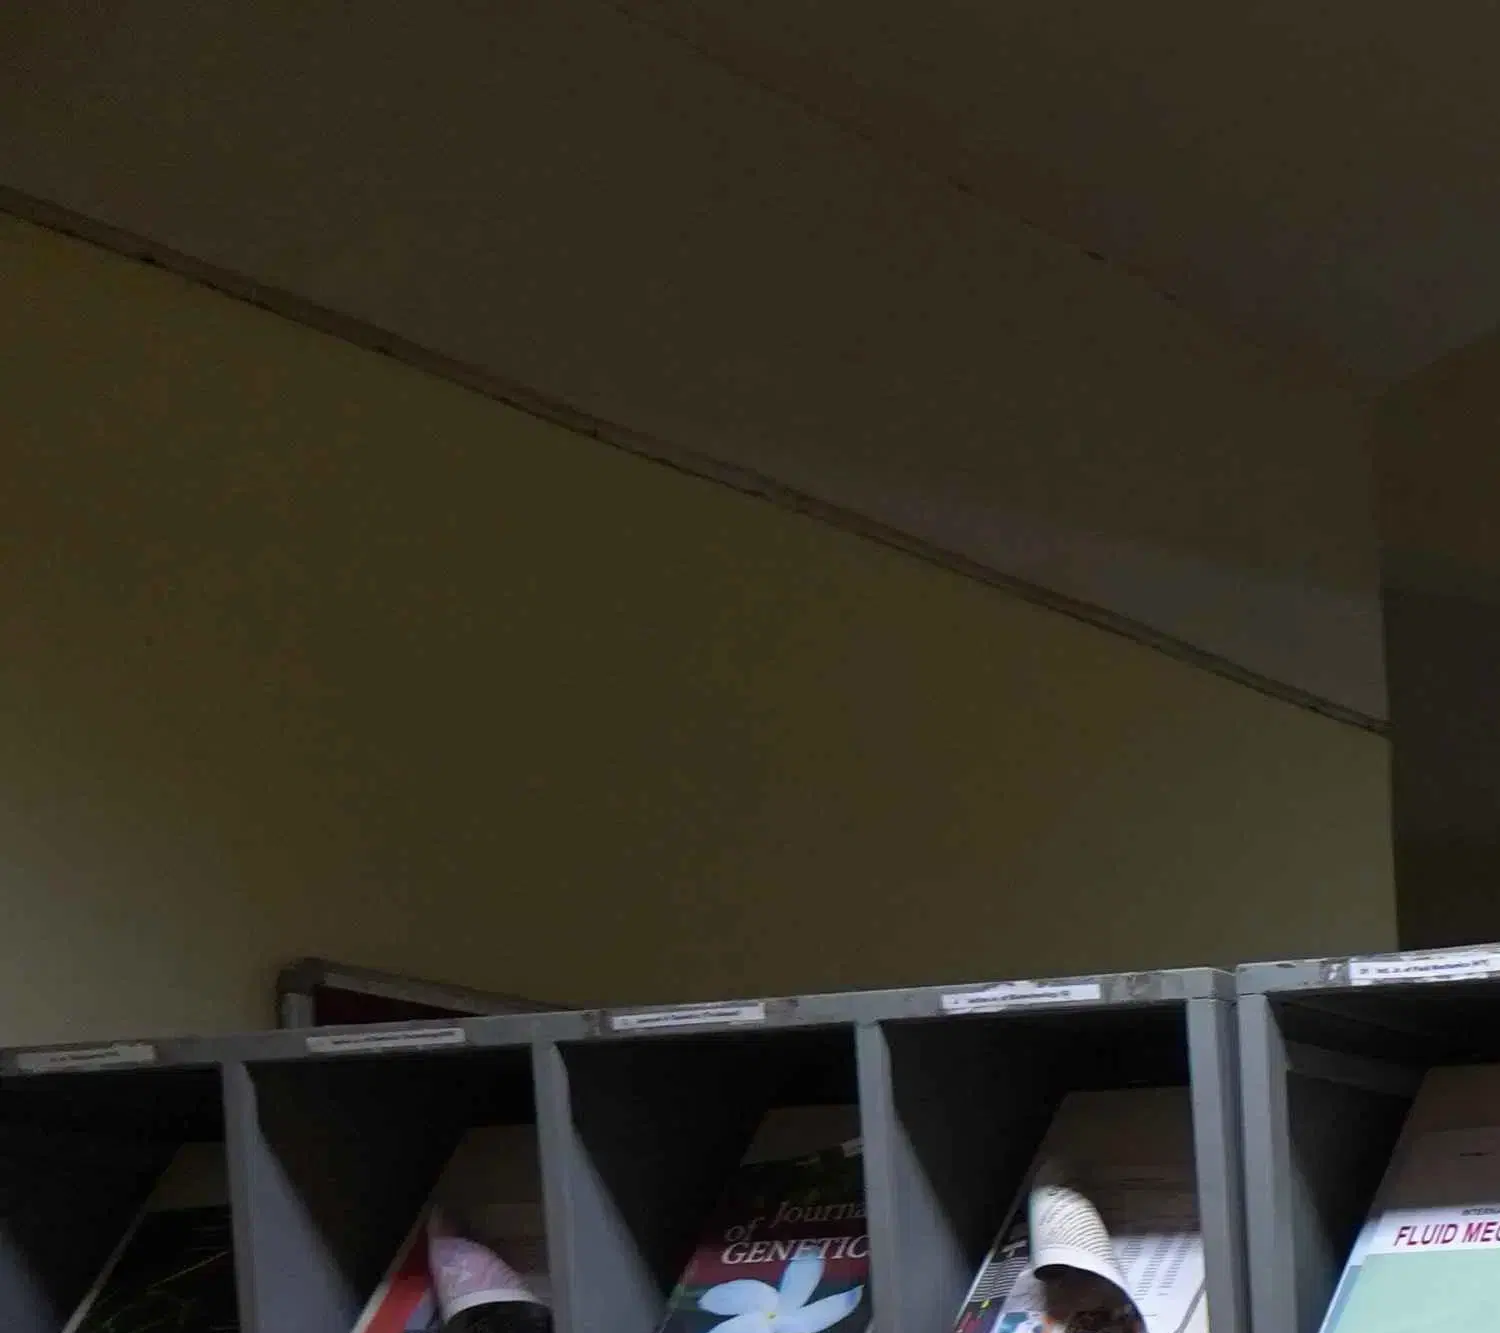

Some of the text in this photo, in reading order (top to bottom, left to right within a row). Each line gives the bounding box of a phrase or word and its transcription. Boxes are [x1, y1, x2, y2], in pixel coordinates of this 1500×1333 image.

[773, 1200, 866, 1226] Journa
[725, 1217, 766, 1242] of
[1393, 1221, 1458, 1248] FLUID
[722, 1234, 872, 1265] GENETIC
